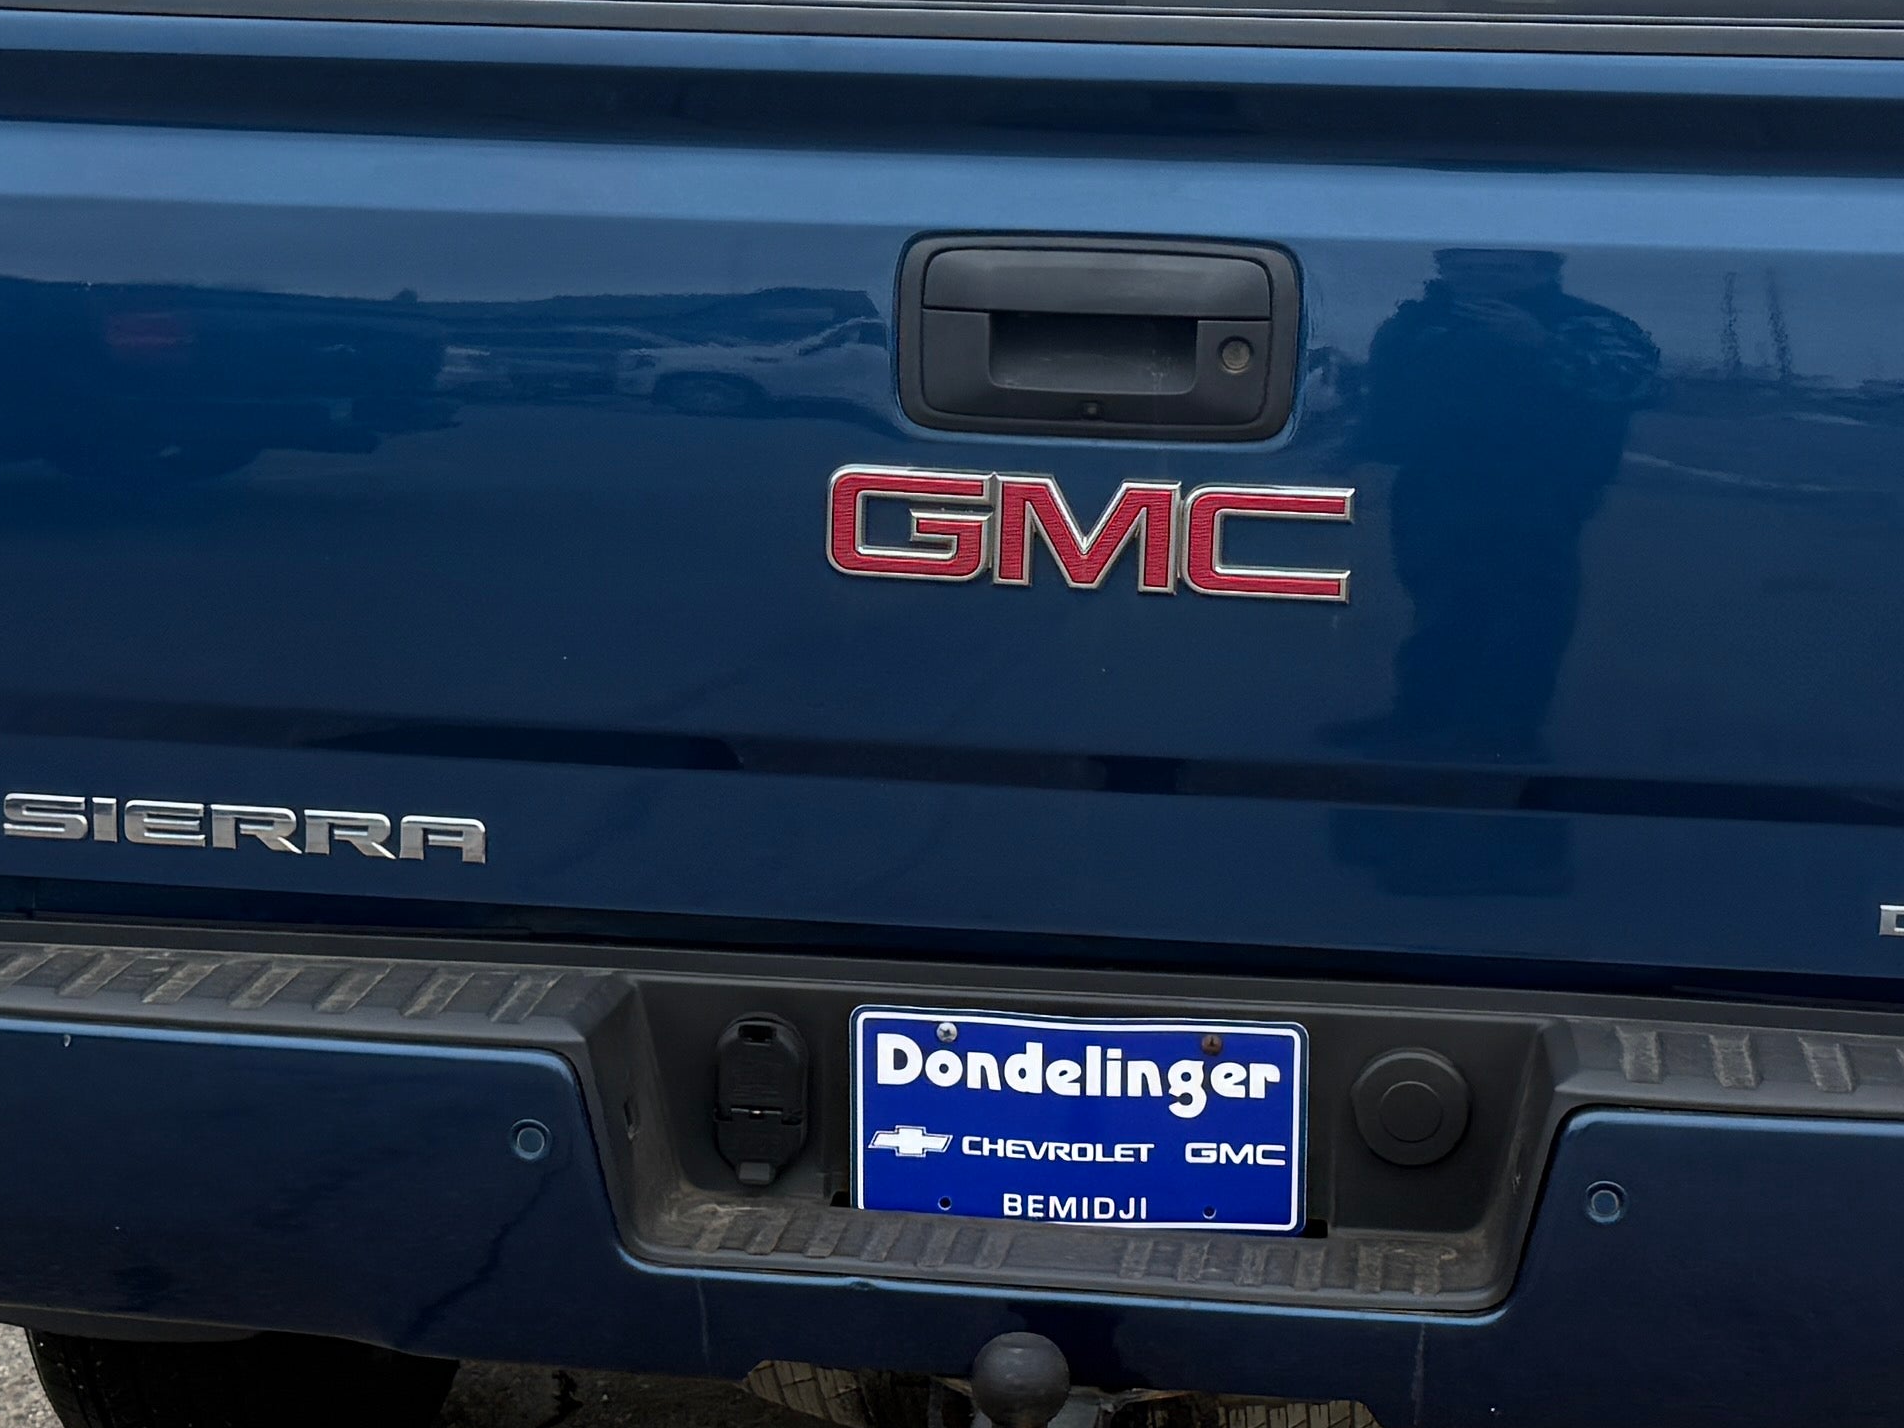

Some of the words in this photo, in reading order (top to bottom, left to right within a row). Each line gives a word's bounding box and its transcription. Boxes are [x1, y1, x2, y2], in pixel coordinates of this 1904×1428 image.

[827, 463, 1356, 604] GMC
[3, 792, 486, 864] SIERRA
[875, 1032, 1281, 1119] Dondelinger
[961, 1135, 1155, 1163] CHEVROLET
[1185, 1142, 1287, 1167] GMC
[1003, 1192, 1147, 1221] BEMIDJI
